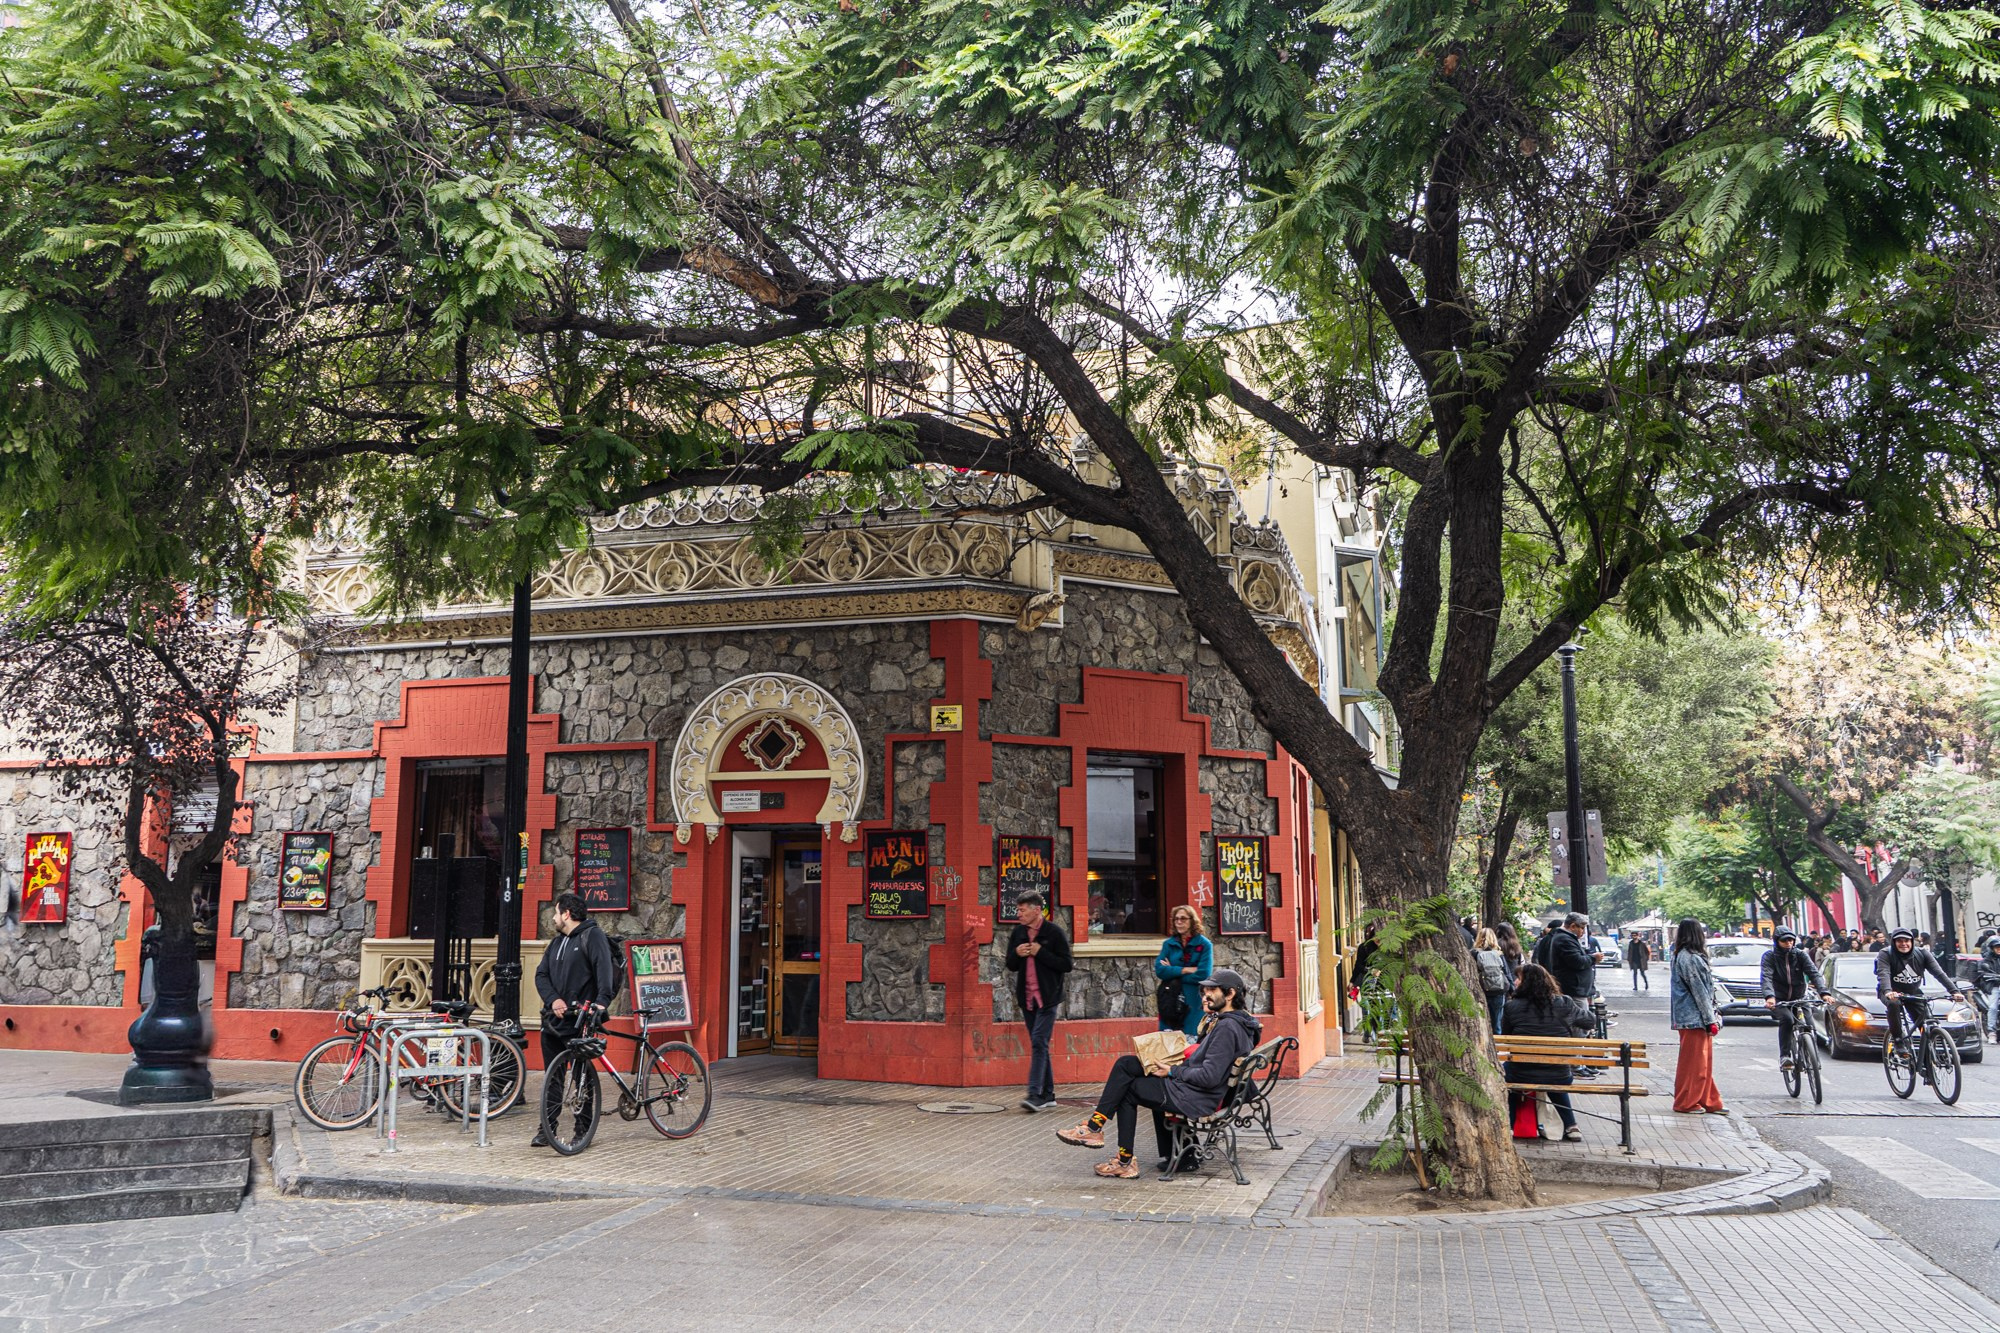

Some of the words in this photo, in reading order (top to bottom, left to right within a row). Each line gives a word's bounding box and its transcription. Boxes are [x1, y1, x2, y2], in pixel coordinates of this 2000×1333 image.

[27, 835, 69, 867] PIZZAS
[870, 837, 928, 868] MENU
[1002, 838, 1020, 850] HAY
[1217, 841, 1260, 866] TROPI
[1000, 845, 1051, 878] PROMO
[1235, 861, 1262, 884] CAL
[584, 888, 592, 901] Y
[1234, 879, 1264, 902] GIN
[649, 947, 682, 961] HAPPY
[651, 959, 684, 974] HOUR
[1893, 975, 1921, 984] adidas
[641, 995, 685, 1008] FUMADORES
